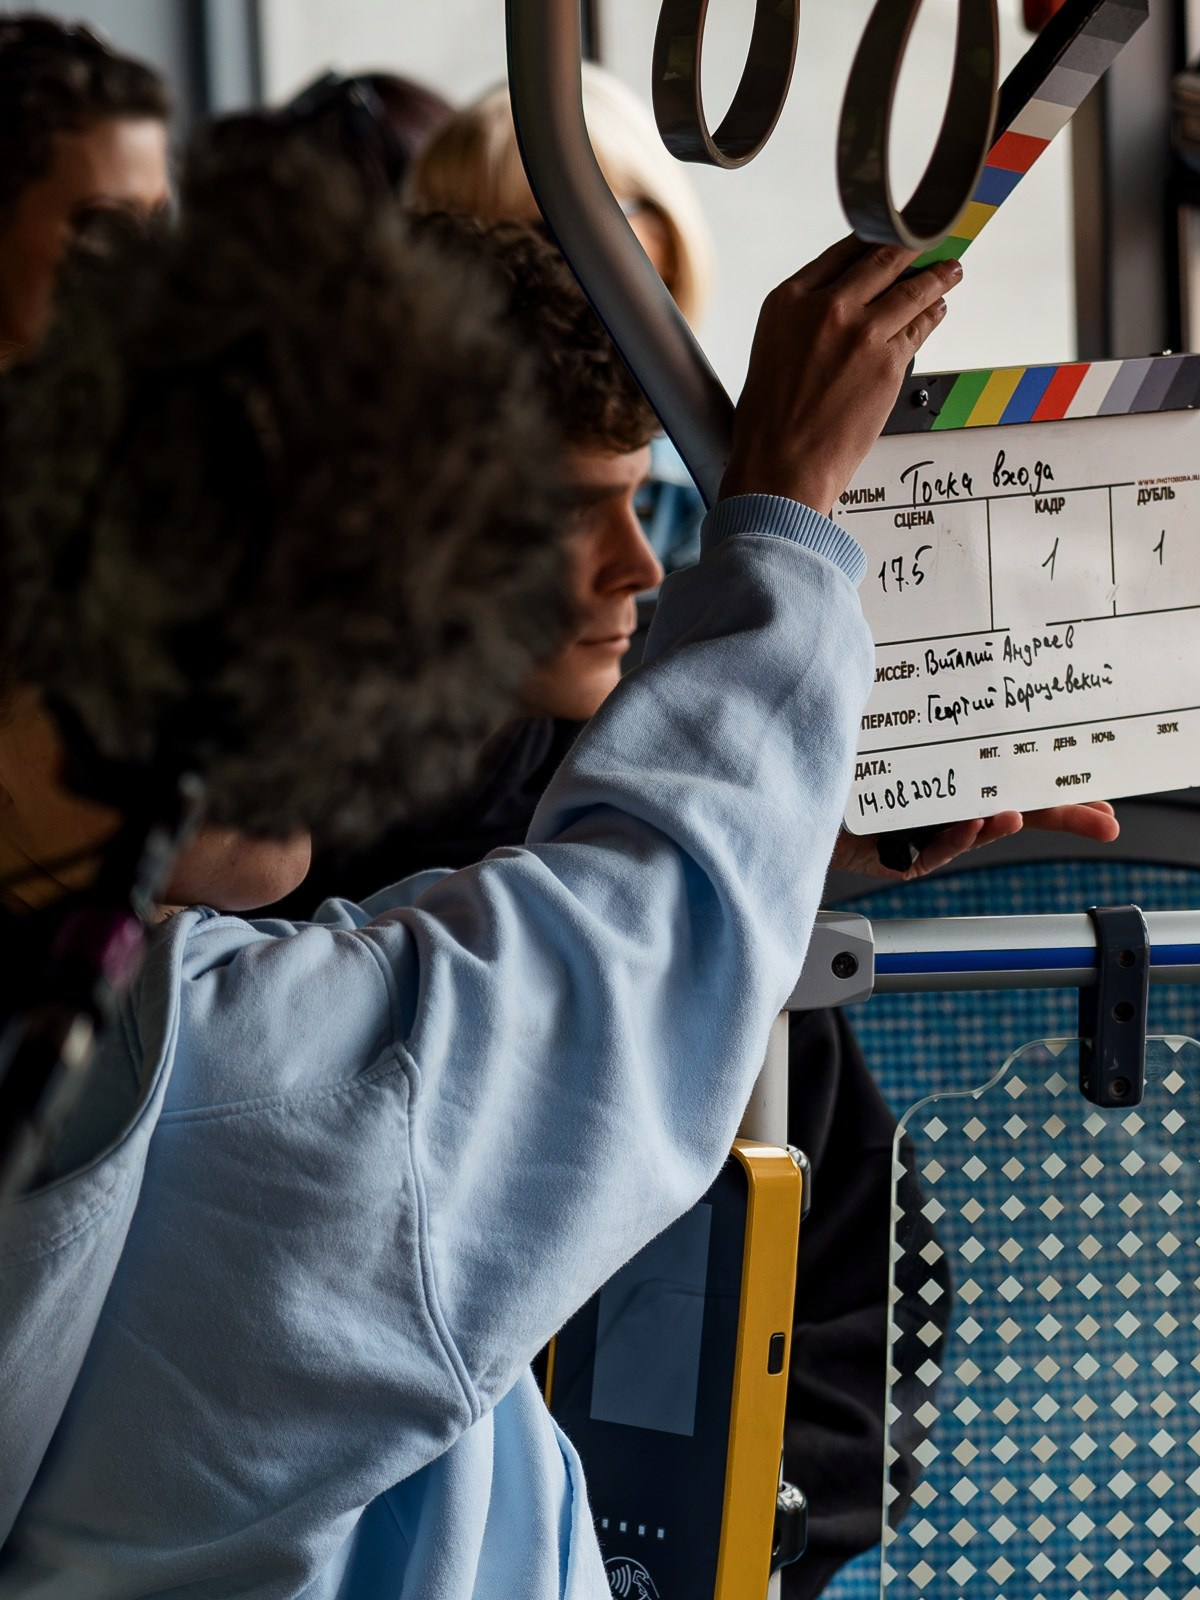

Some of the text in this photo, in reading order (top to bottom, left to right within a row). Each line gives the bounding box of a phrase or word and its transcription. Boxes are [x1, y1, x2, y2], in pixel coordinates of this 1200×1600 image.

[900, 450, 1054, 508] Точка входа
[1035, 497, 1066, 515] КАДР
[1137, 486, 1176, 506] ДУБЛЬ
[894, 510, 935, 530] СЦЕНА
[1153, 529, 1165, 566] 1
[878, 545, 933, 592] 17.5
[1042, 537, 1059, 581] 1
[925, 625, 1075, 676] Виталий Андреев
[860, 709, 921, 730] ПЕРАТОР:
[979, 722, 1179, 760] ИНТ. ЭКСТ. ДЕНЬ НОЧЬ ЗВУК
[854, 759, 892, 781] ДАТА:
[1055, 772, 1092, 788] ФИЛЬТР
[981, 786, 998, 799] FPS
